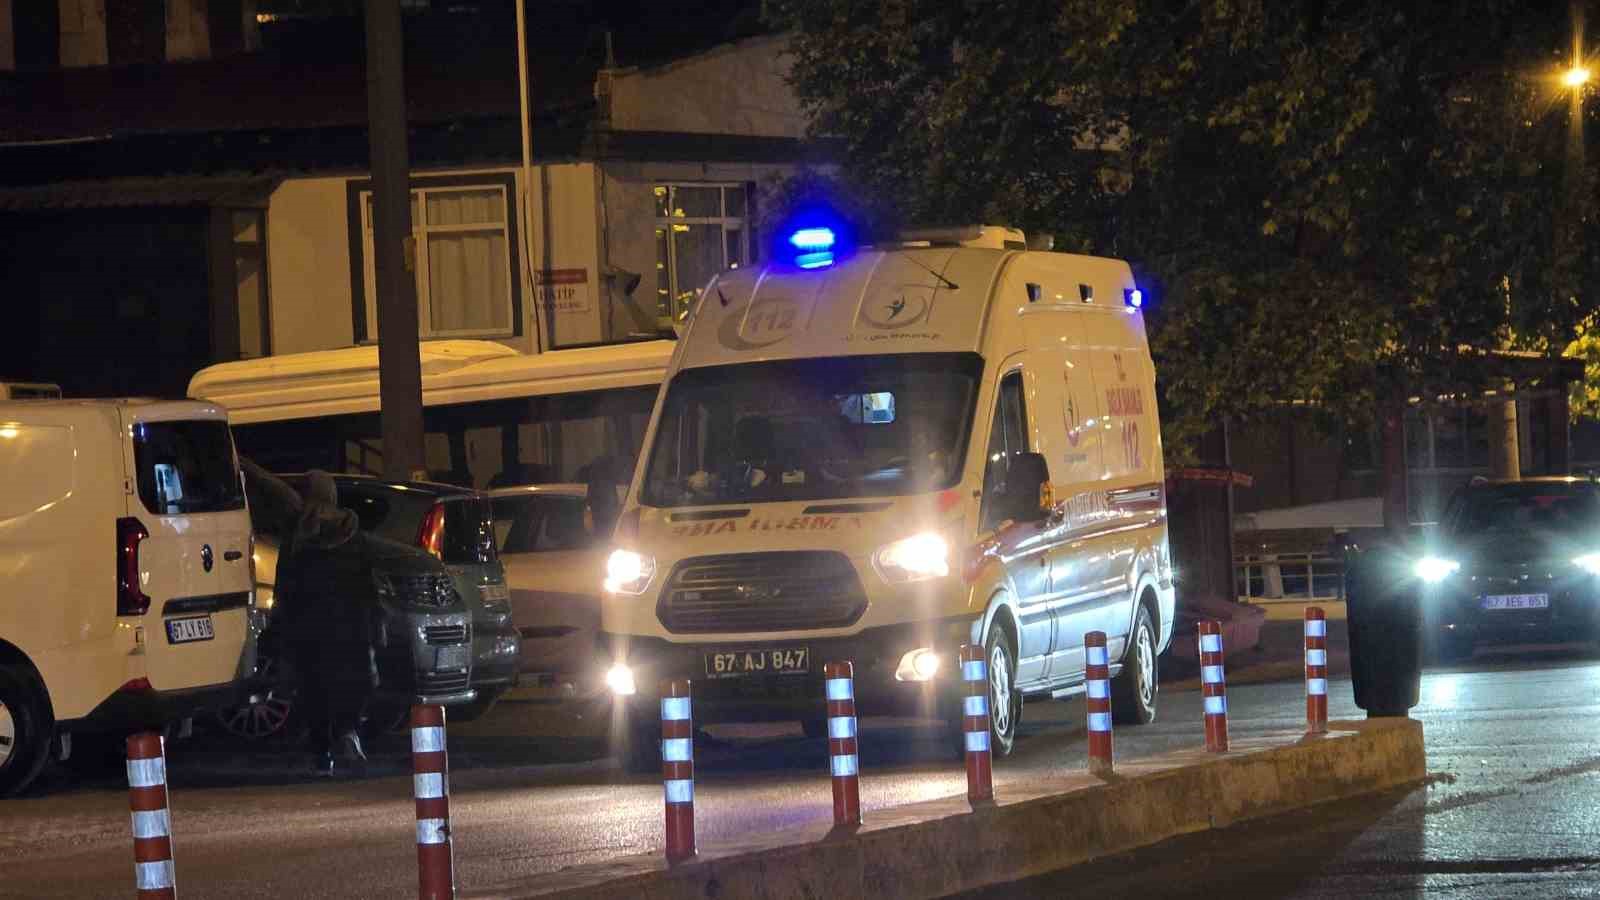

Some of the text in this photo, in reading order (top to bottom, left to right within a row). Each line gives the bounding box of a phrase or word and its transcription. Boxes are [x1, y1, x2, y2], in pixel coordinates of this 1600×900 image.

[714, 649, 806, 672] 67 AJ 847
